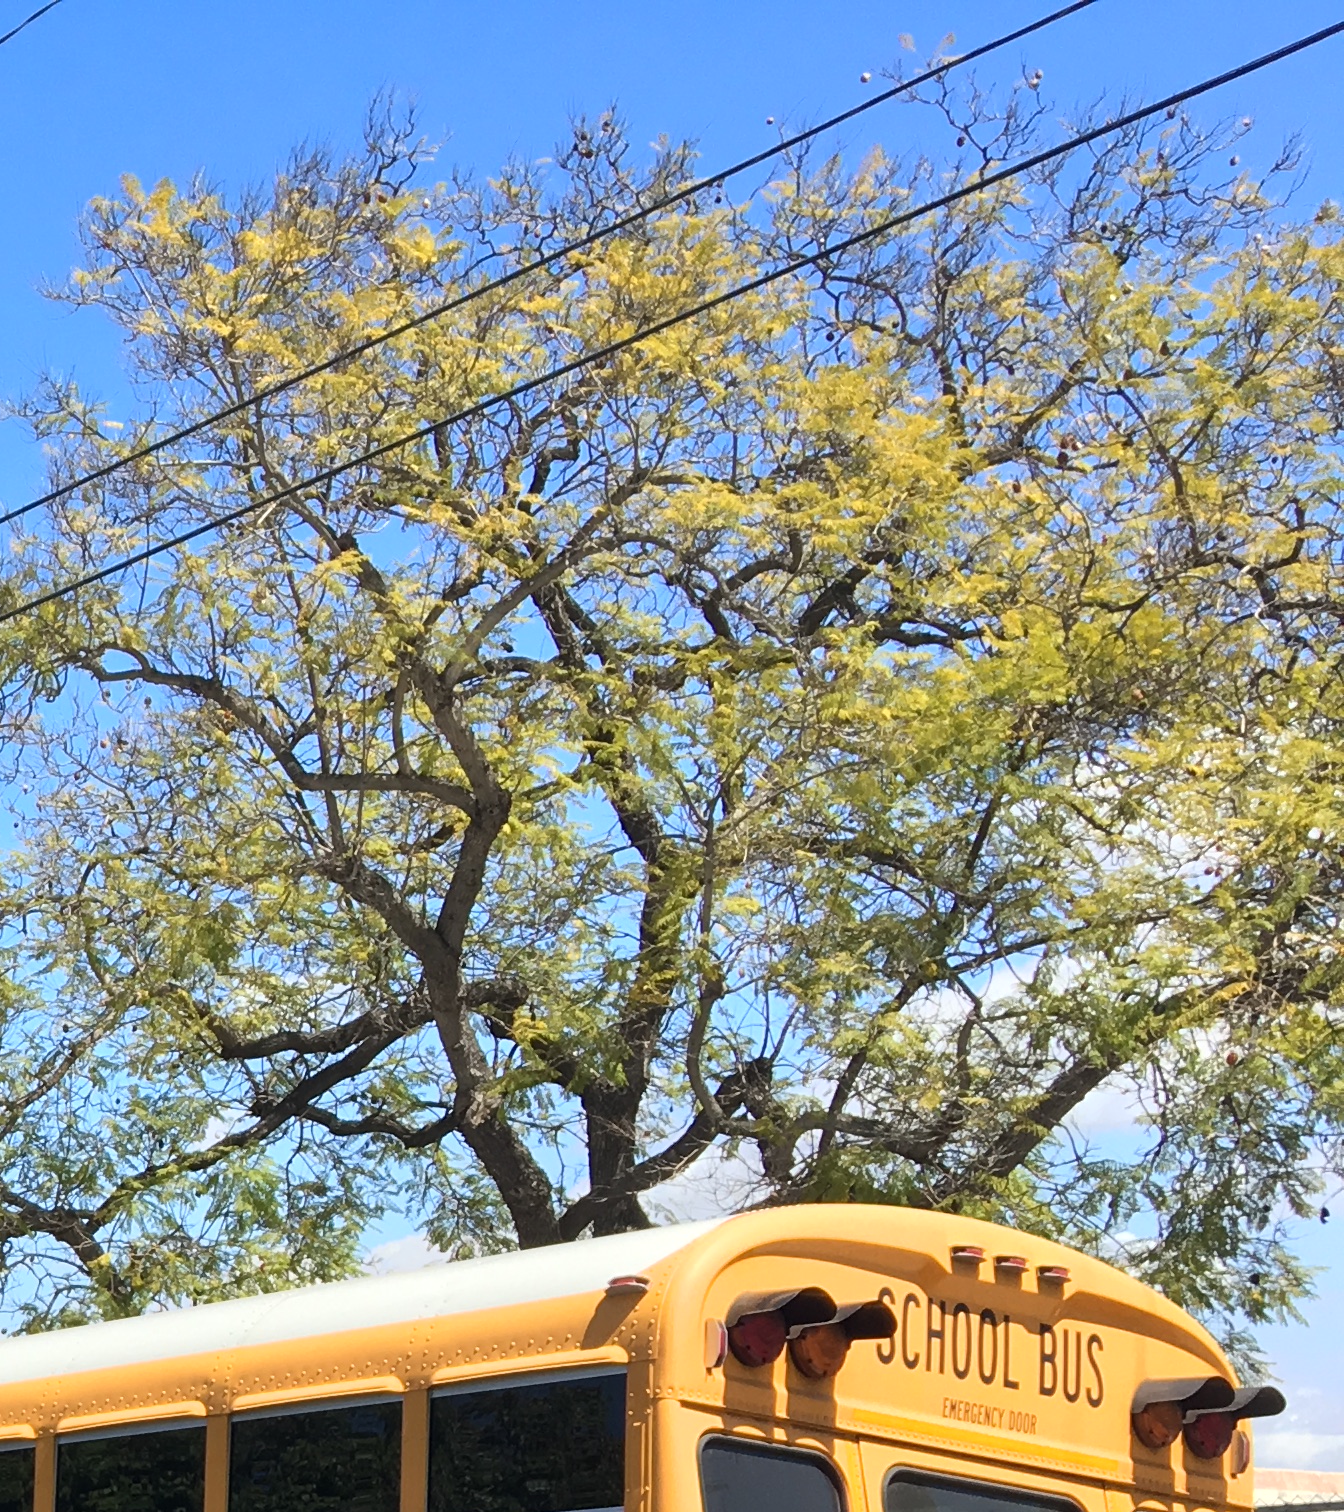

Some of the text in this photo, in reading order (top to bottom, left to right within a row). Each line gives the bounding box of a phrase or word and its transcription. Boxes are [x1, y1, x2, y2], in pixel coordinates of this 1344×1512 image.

[876, 1286, 1104, 1408] SCHOOL BUS
[942, 1396, 1037, 1435] EMERGENCY DOOR
